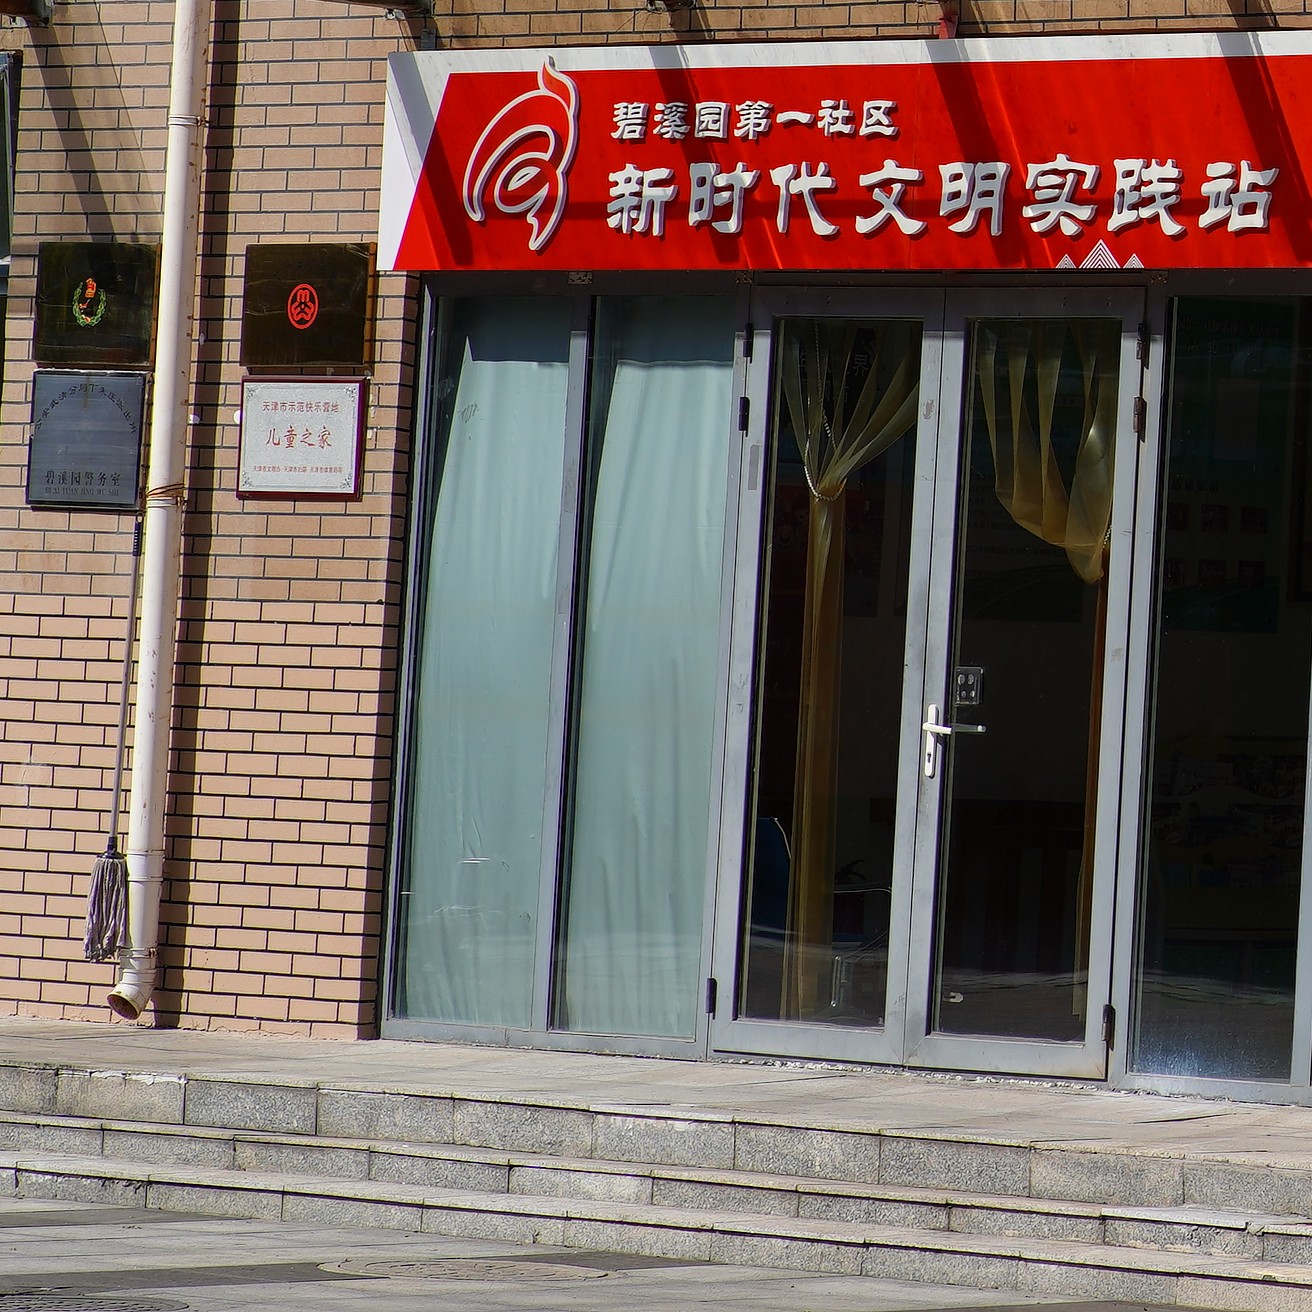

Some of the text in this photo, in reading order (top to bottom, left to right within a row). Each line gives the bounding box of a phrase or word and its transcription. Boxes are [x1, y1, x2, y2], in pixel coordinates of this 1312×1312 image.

[610, 99, 900, 140] 碧溪园第一社区
[605, 153, 1281, 238] 新时代文明实践站
[262, 401, 339, 413] 天津市示范快乐营地
[266, 425, 332, 449] 儿童之家
[45, 470, 121, 486] 碧溪园警务室
